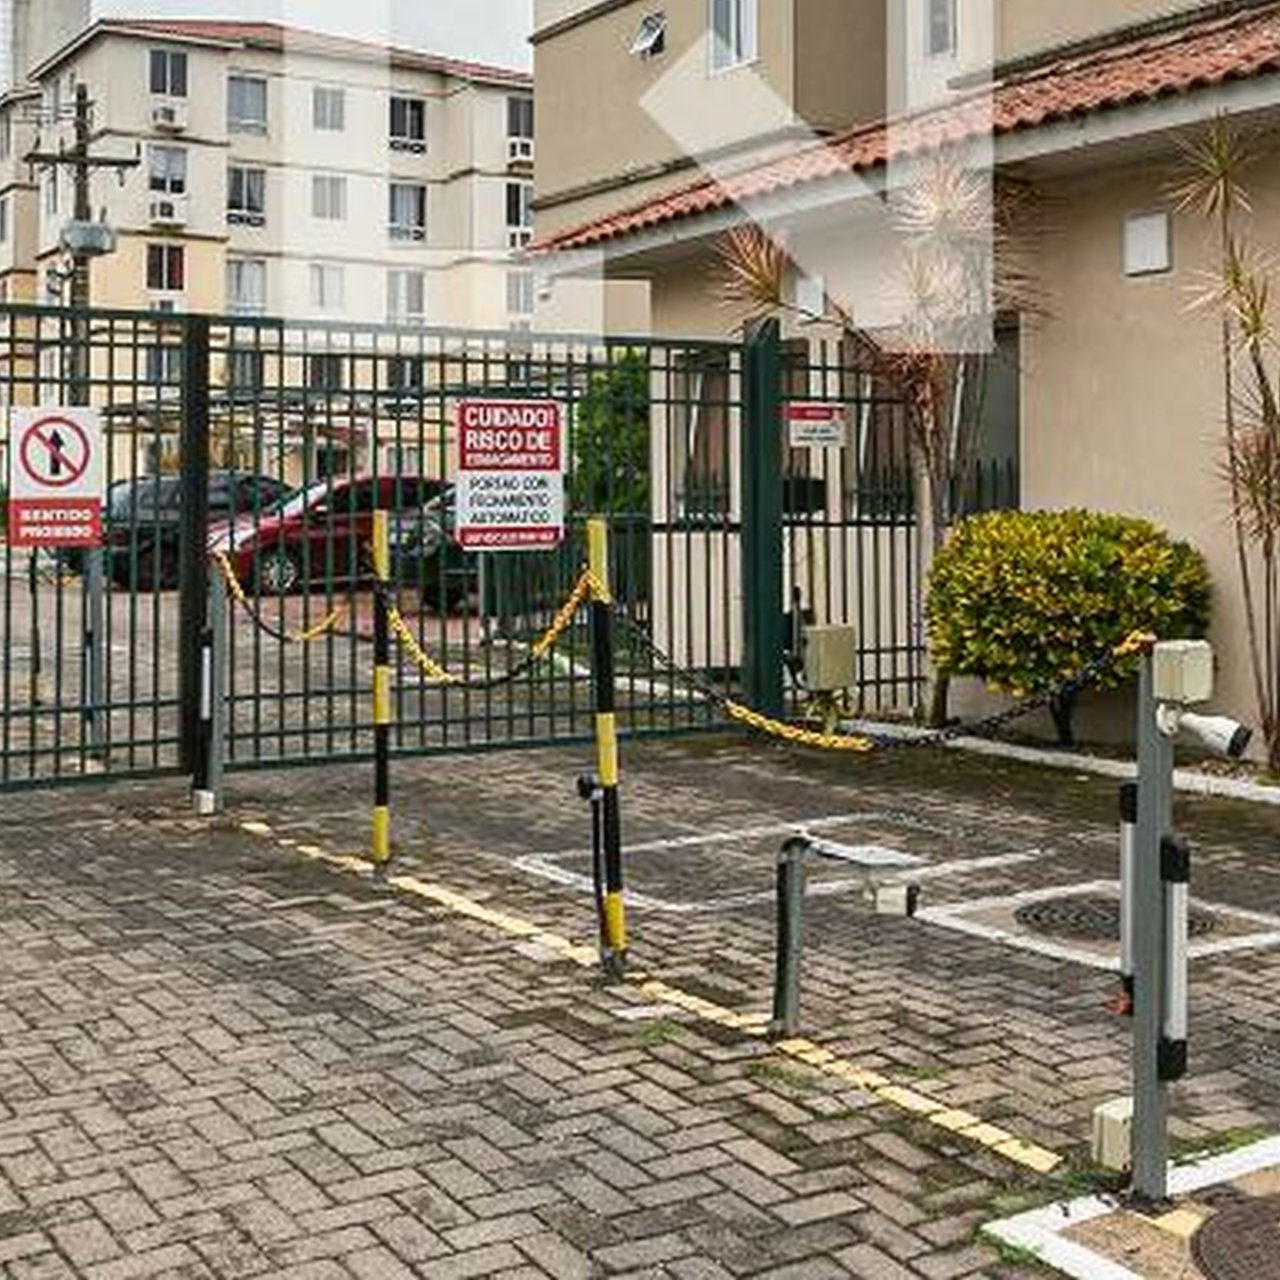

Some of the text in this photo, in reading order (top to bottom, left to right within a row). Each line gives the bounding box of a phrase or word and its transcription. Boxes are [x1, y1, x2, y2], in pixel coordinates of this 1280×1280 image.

[465, 406, 555, 427] CUIDADO!
[465, 431, 553, 451] RISCO DE
[19, 508, 94, 522] SENTIDO
[18, 525, 94, 539] PROIBIDO
